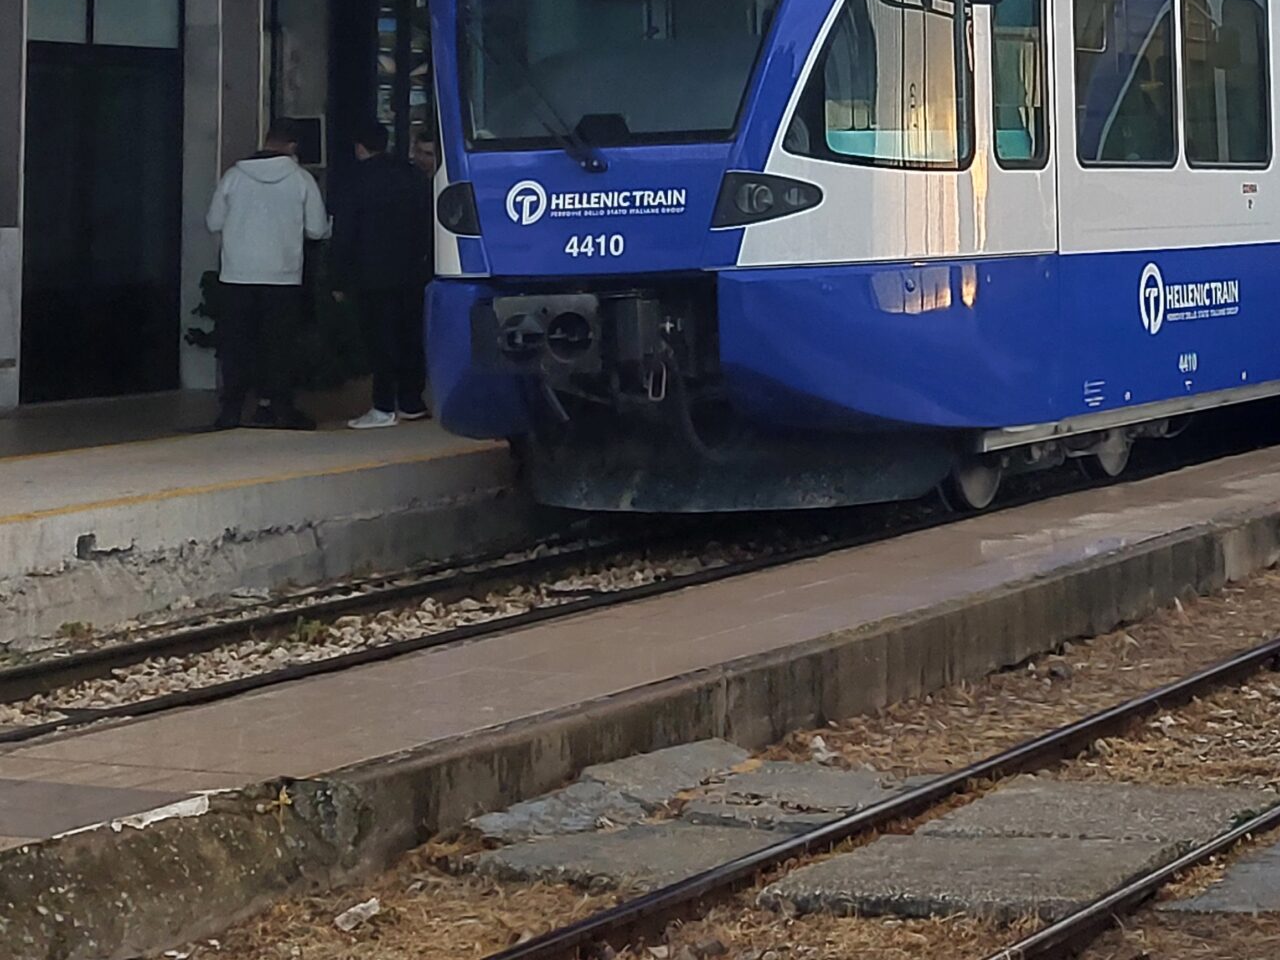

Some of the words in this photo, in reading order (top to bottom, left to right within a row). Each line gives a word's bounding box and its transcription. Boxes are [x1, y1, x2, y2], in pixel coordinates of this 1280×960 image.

[550, 191, 631, 210] HELLENIC
[632, 189, 686, 207] TRAIN
[564, 234, 624, 257] 4410
[1165, 282, 1210, 310] HELLENIC
[1210, 279, 1239, 306] TRAIN
